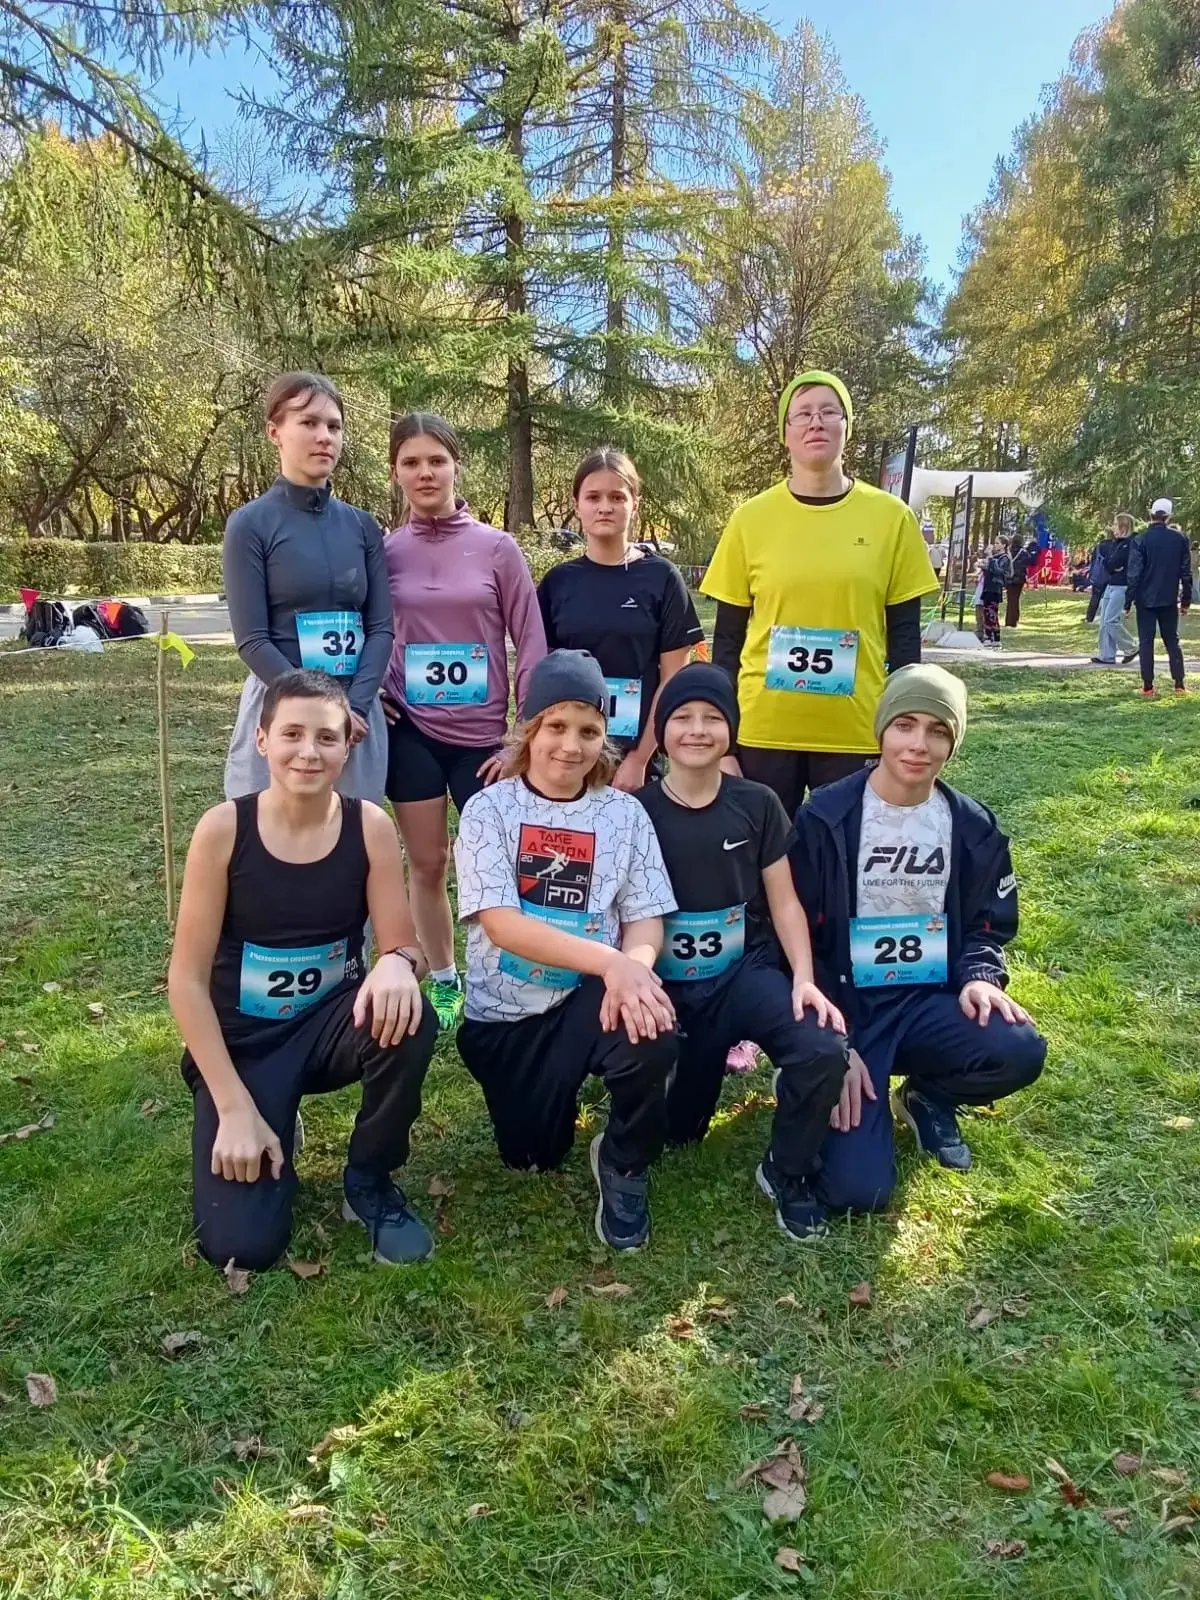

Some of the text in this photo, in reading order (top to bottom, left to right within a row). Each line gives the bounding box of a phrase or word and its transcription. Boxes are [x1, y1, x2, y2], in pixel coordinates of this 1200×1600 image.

[322, 630, 357, 656] 32
[787, 646, 833, 675] 35
[426, 661, 468, 686] 30
[527, 841, 587, 858] ACTION
[538, 830, 573, 845] TAKE
[520, 854, 534, 863] 20
[863, 845, 945, 875] FILA
[862, 879, 880, 887] LIVE
[881, 879, 898, 887] FOR
[898, 879, 917, 888] THE
[999, 872, 1016, 890] NIK
[672, 931, 723, 960] 33
[874, 934, 923, 965] 28
[267, 967, 322, 997] 29
